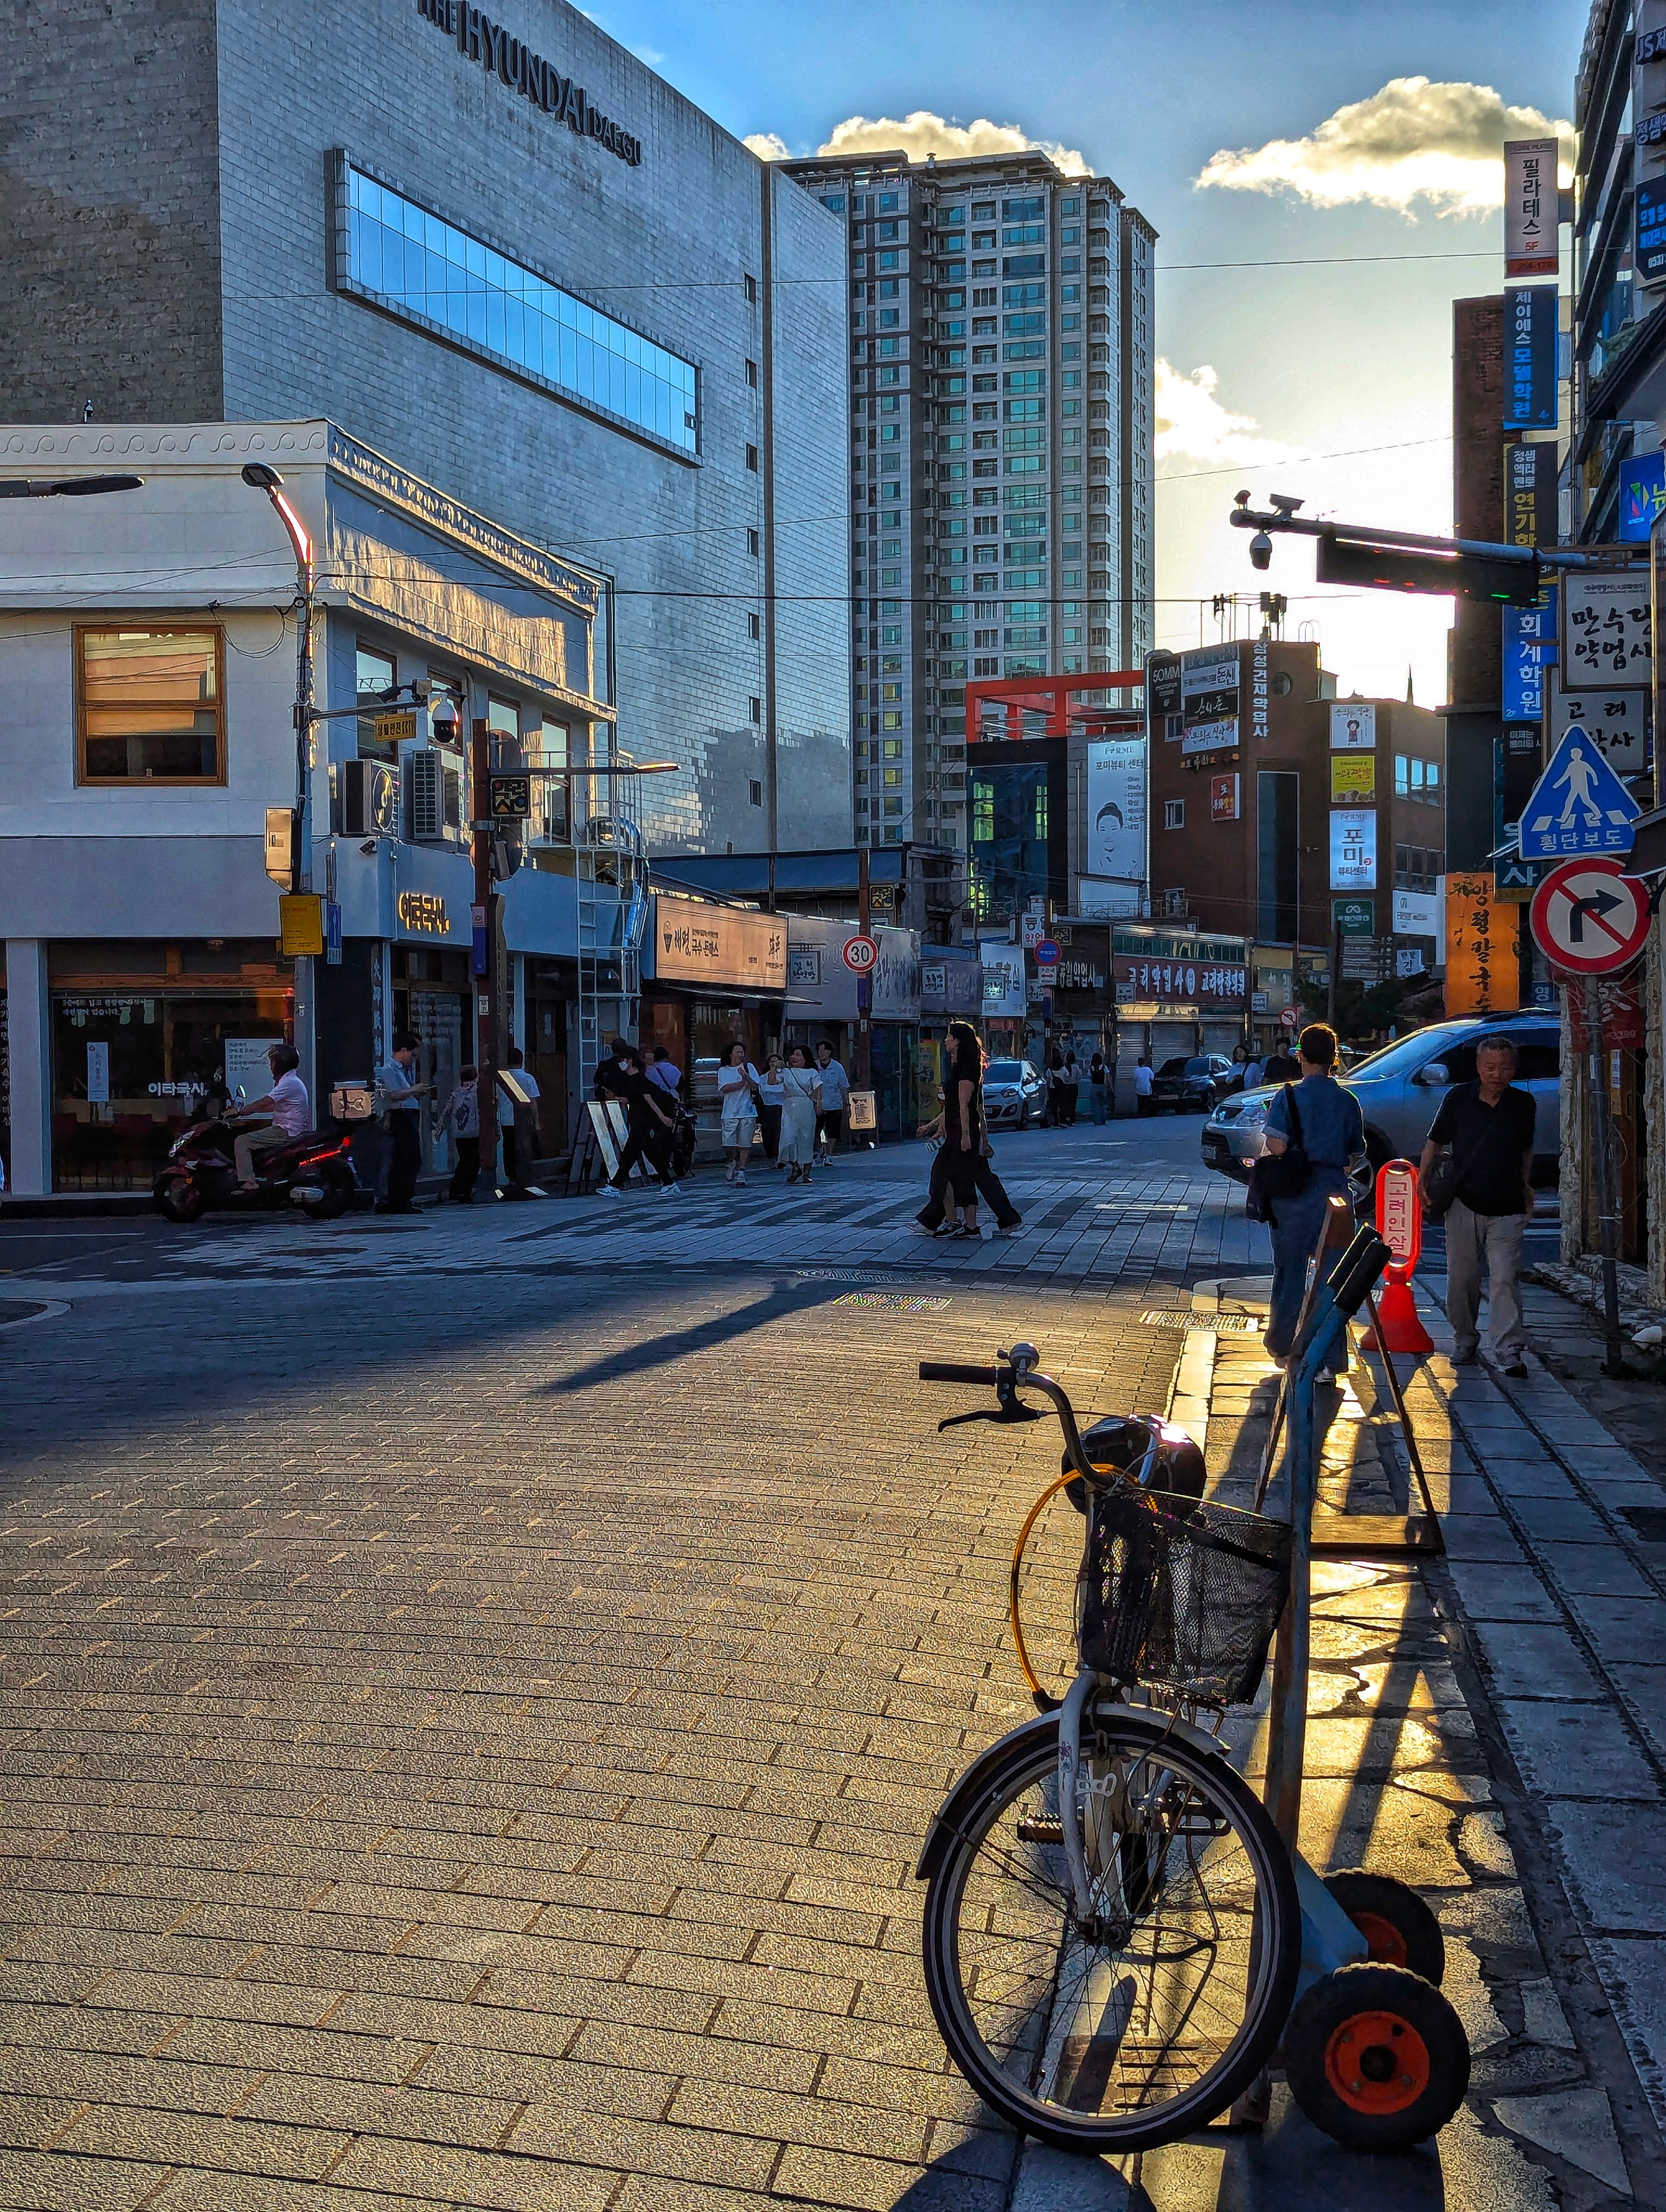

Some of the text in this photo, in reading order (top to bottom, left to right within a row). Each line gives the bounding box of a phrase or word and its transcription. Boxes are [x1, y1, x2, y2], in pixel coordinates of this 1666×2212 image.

[457, 0, 593, 136] HYUNDAI
[1522, 158, 1541, 235] 필라테스
[1518, 614, 1543, 714] 회계학원
[1540, 829, 1623, 851] 횡단보도
[851, 945, 869, 962] 30
